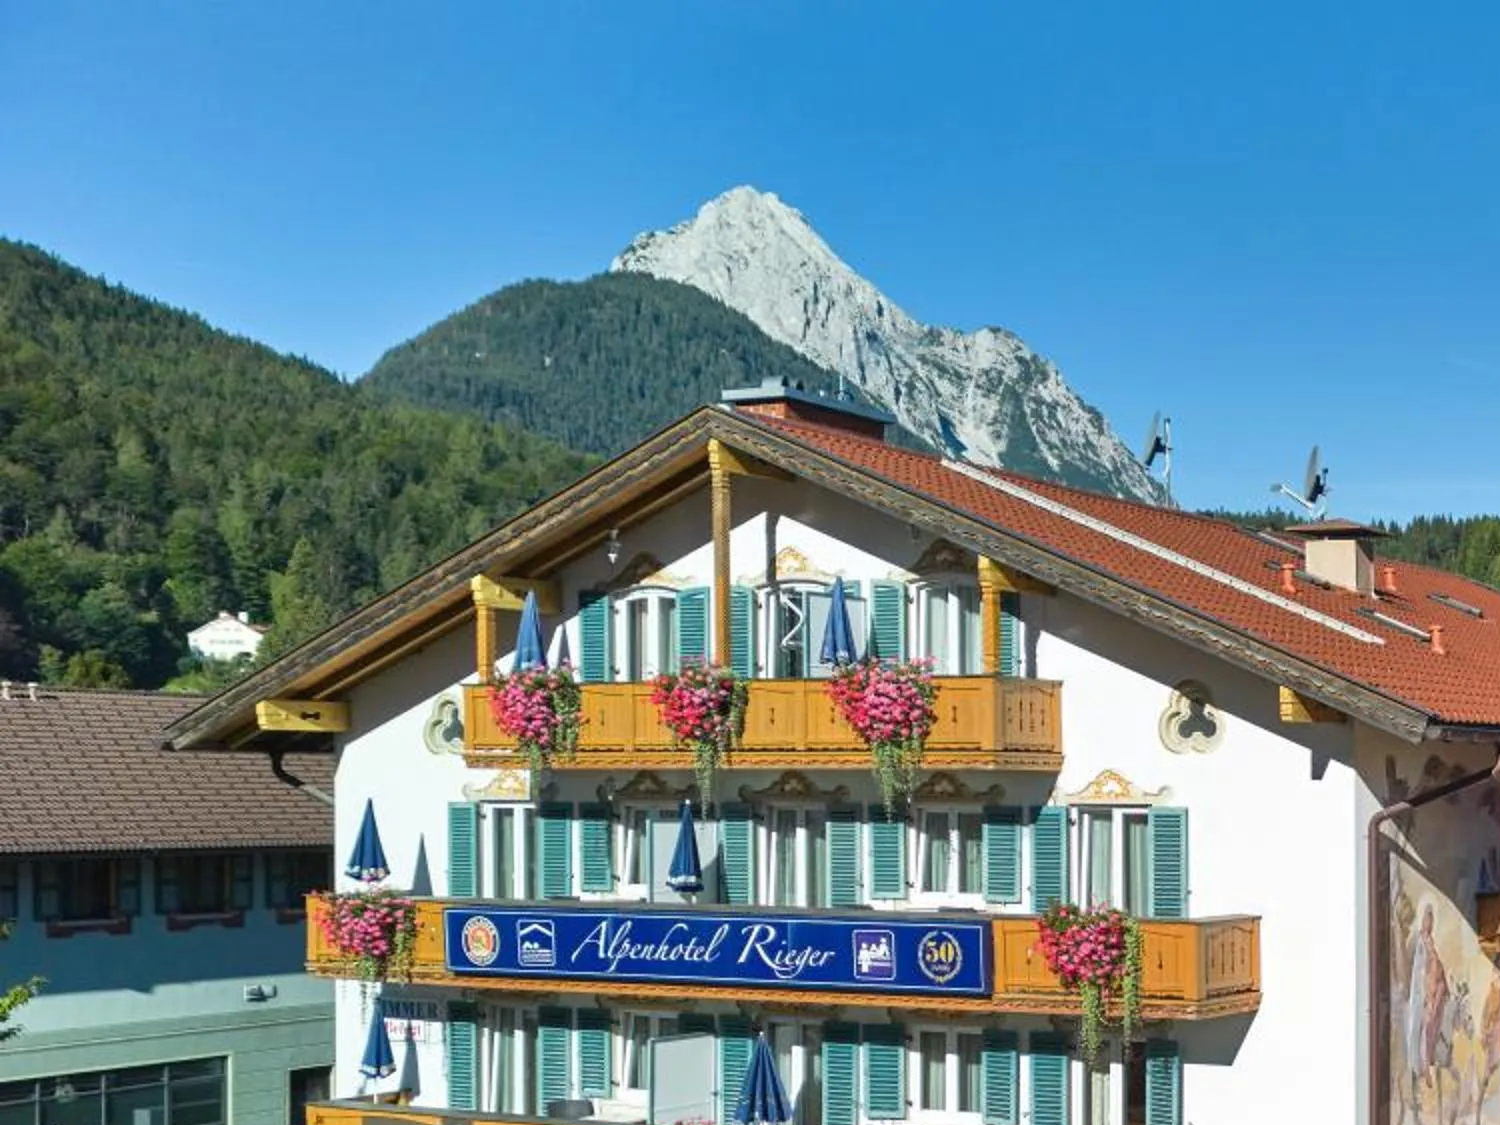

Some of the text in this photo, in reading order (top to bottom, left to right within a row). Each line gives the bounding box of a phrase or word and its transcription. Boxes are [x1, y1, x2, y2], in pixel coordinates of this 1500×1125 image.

[571, 920, 836, 979] Alpenhotel Rieger
[926, 941, 956, 963] 50
[380, 1000, 439, 1019] IMMER
